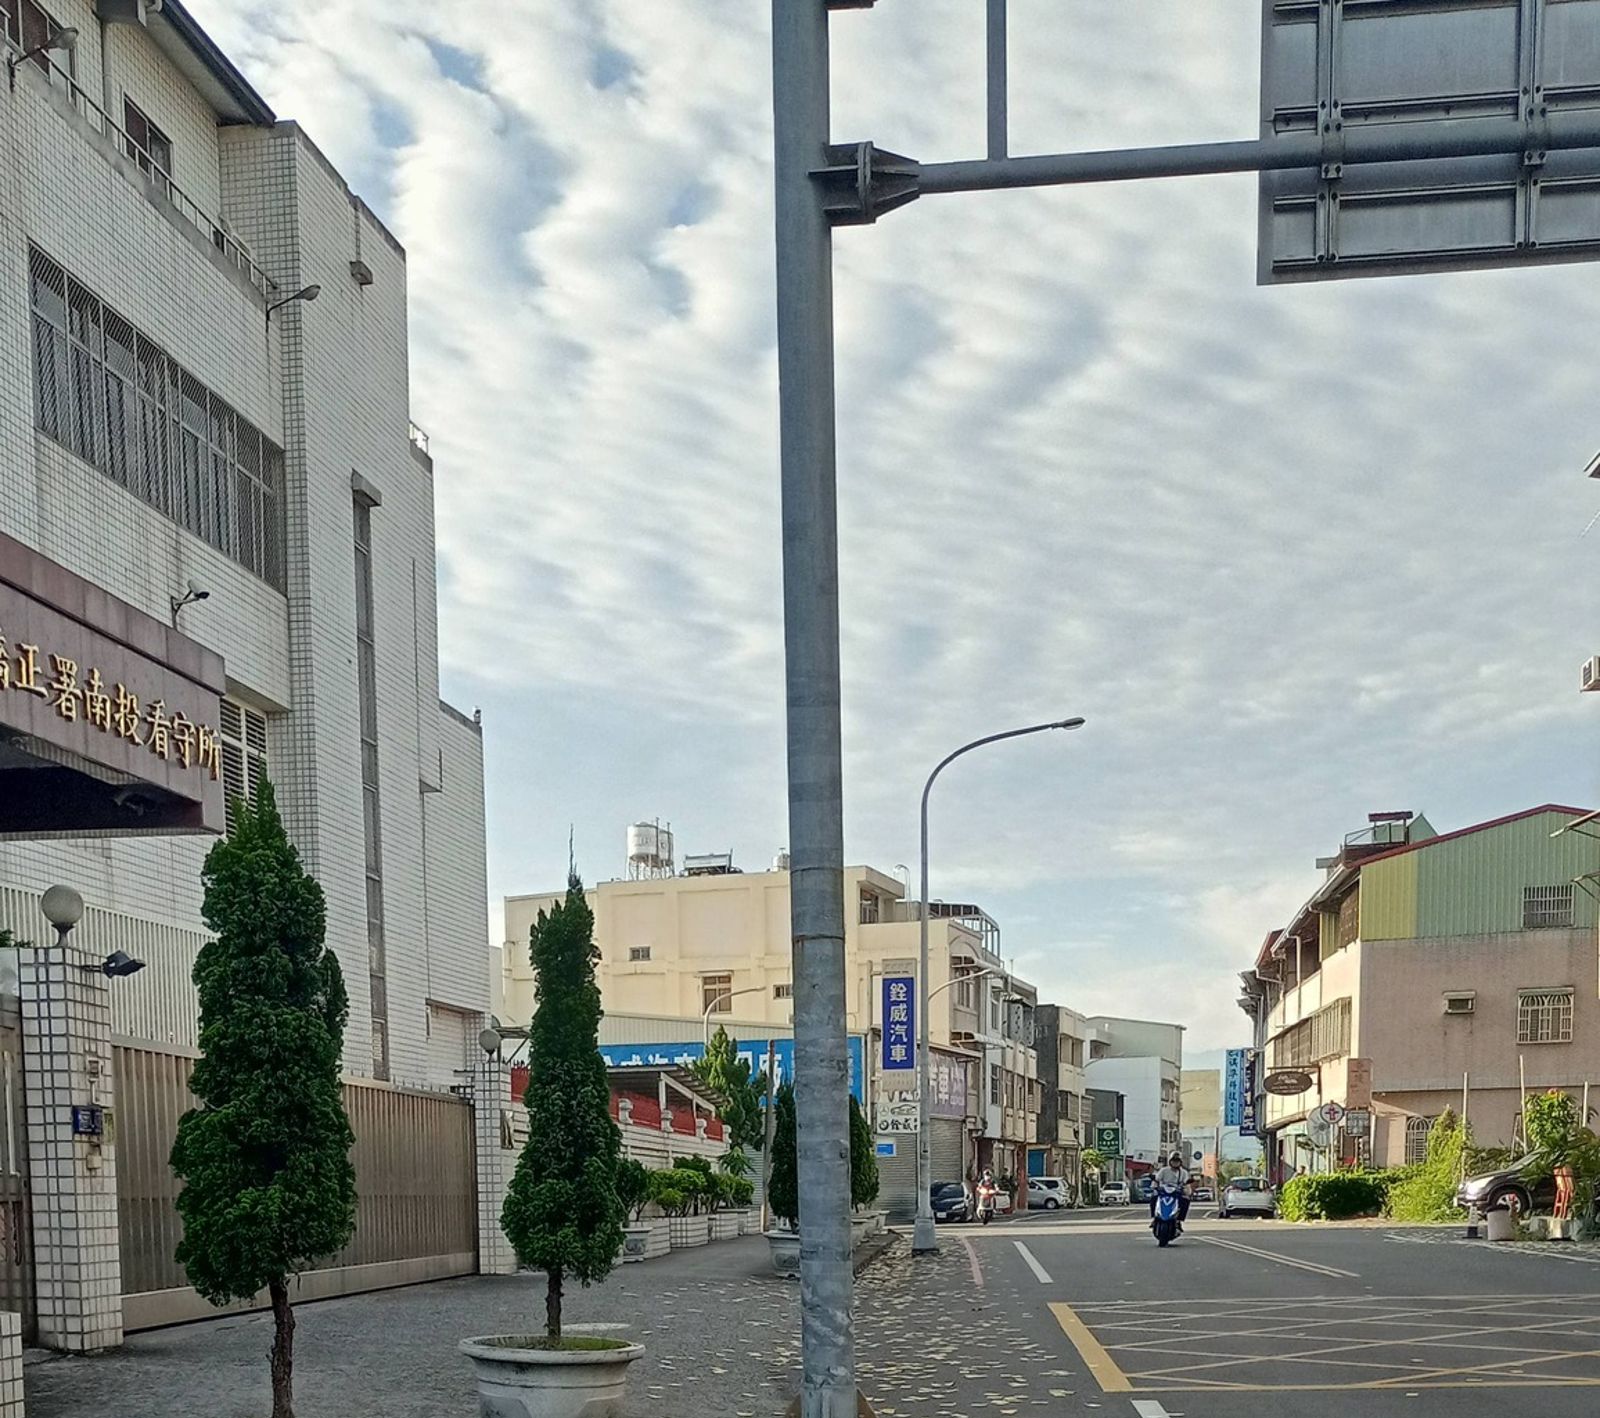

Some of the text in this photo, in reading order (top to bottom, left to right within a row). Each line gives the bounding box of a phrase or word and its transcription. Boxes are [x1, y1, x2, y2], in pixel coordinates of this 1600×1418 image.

[0, 628, 221, 780] 正署南投看守所
[889, 983, 908, 1062] 銓威汽車
